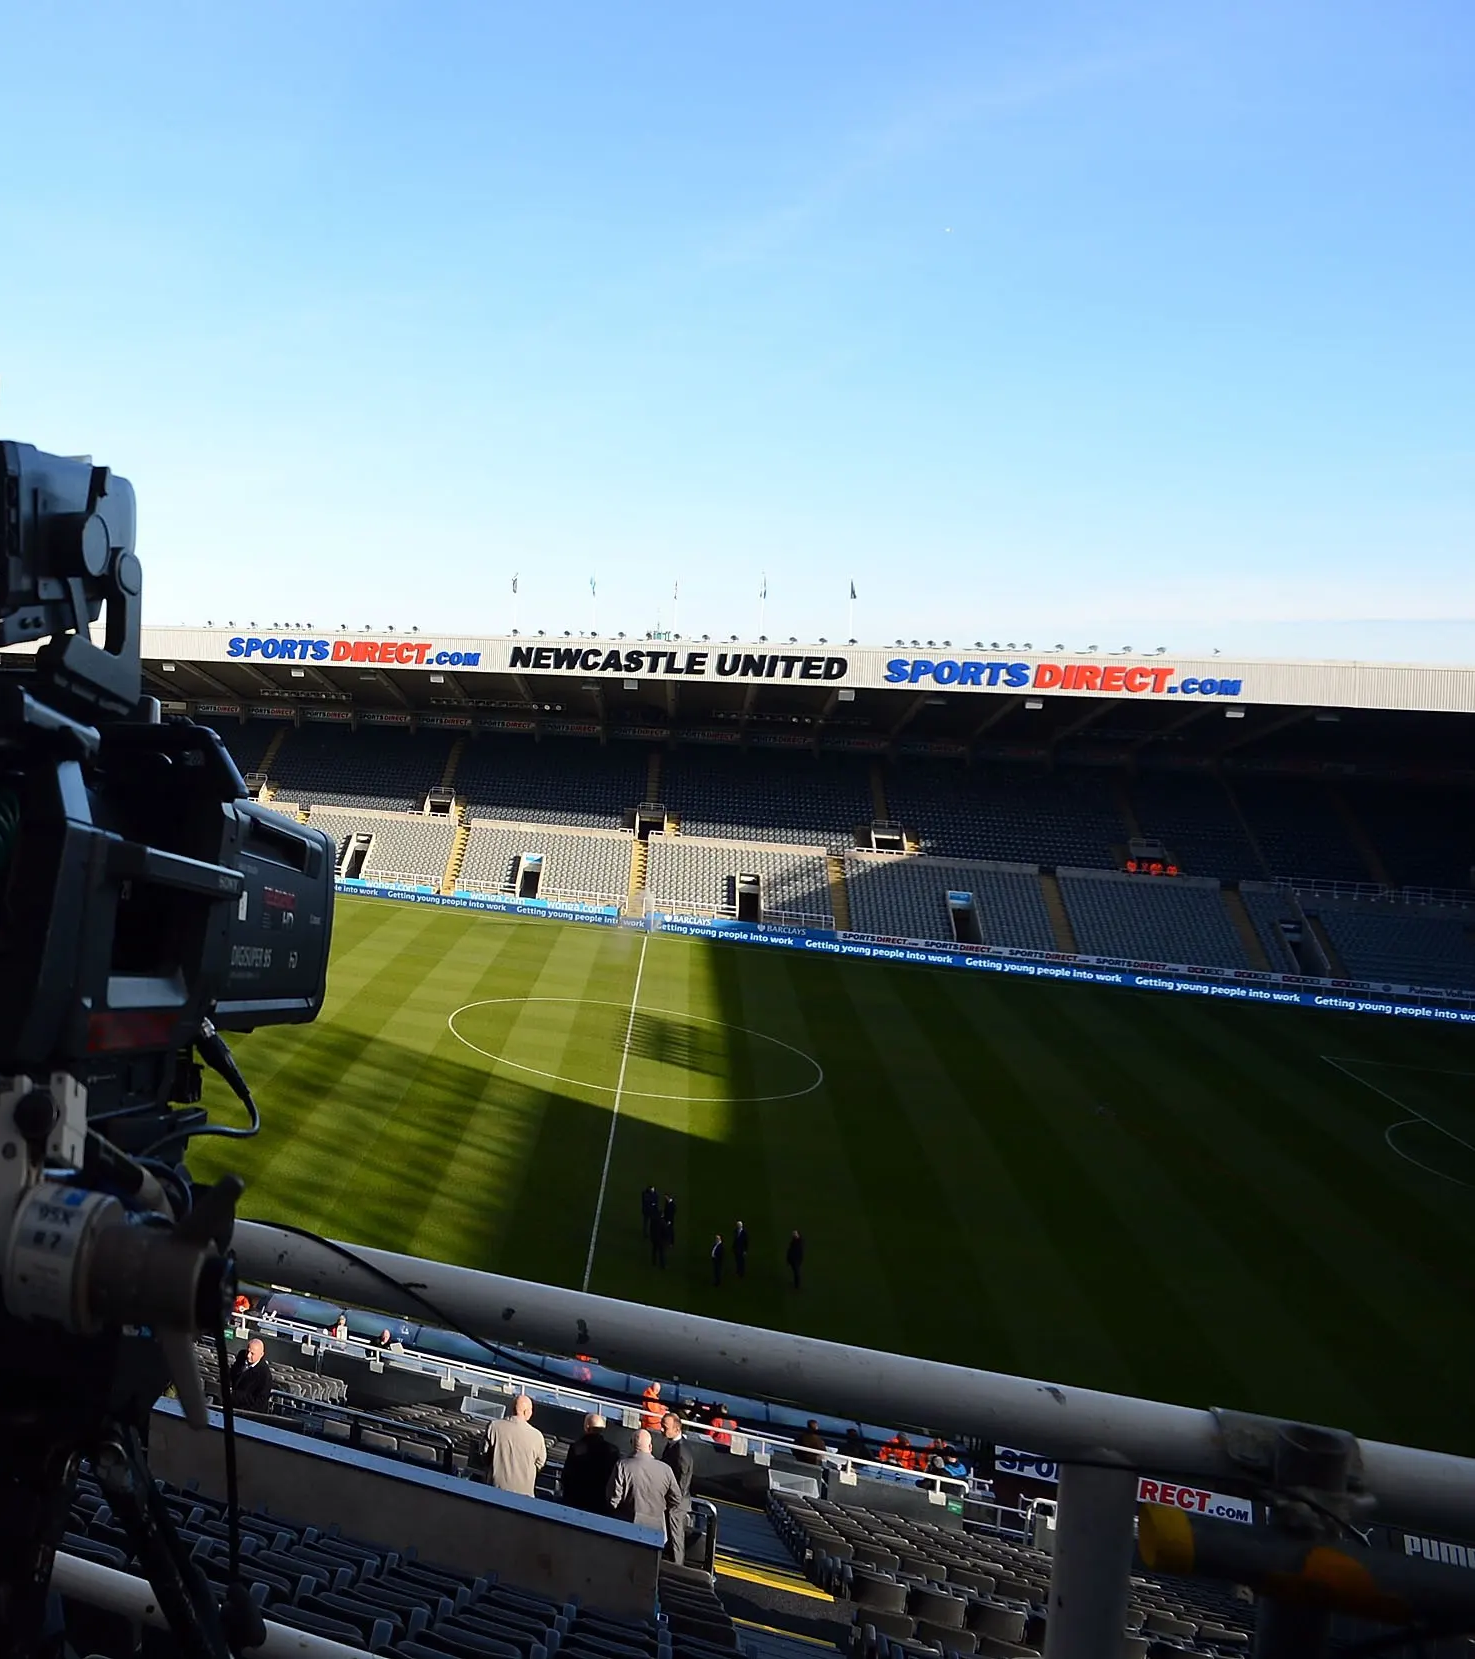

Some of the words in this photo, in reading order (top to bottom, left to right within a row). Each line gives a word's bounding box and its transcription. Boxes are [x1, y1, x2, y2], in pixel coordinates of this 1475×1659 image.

[508, 646, 709, 677] NEWCASTLE
[715, 653, 848, 681] UNITED
[359, 888, 379, 897] work
[387, 890, 416, 902] Getting
[417, 894, 440, 905] young
[441, 897, 468, 908] people
[469, 900, 485, 909] into
[486, 902, 507, 912] work
[516, 905, 547, 917] Getting
[548, 910, 574, 922] young
[575, 913, 603, 925] people
[623, 918, 645, 928] work
[674, 914, 712, 927] BARCLAYS
[689, 927, 717, 939] young
[718, 930, 748, 942] people
[750, 932, 769, 943] into
[770, 936, 794, 946] work
[766, 924, 807, 936] BARCLAYS
[805, 939, 840, 953] Getting
[841, 944, 871, 957] young
[872, 947, 904, 960] people
[906, 951, 926, 961] into
[927, 954, 953, 965] work
[965, 957, 1003, 971] Getting
[1004, 962, 1035, 975] young
[1037, 966, 1071, 979] people
[1072, 968, 1094, 980] into
[1095, 972, 1123, 983] work
[1134, 976, 1175, 991] Getting
[1176, 981, 1209, 995] young
[1211, 984, 1247, 999] people
[1248, 988, 1271, 1000] into
[1272, 992, 1301, 1003] work
[1314, 995, 1356, 1011] Getting
[1357, 1001, 1393, 1015] young
[1394, 1005, 1432, 1019] people
[1434, 1008, 1459, 1020] into
